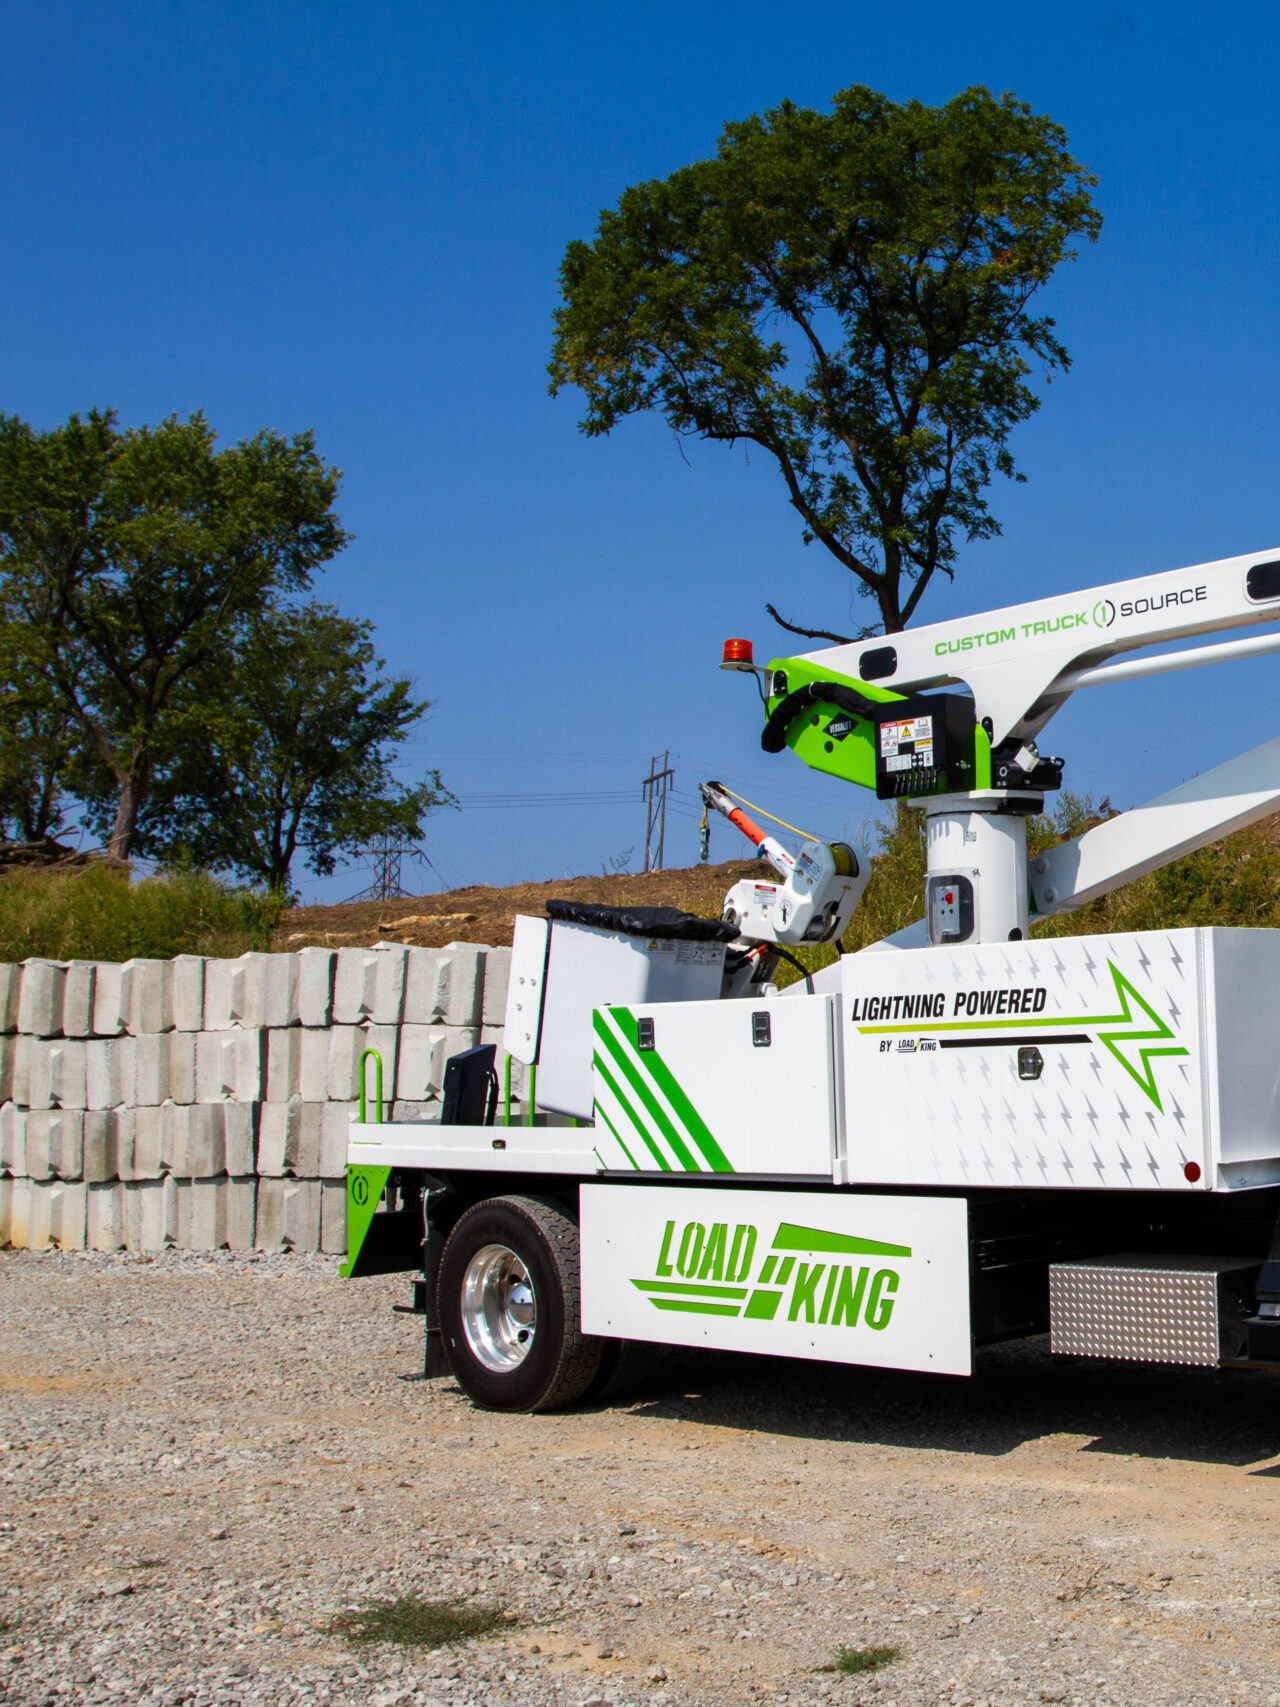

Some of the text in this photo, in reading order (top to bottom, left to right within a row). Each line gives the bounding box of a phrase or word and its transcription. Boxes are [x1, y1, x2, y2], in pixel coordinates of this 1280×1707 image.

[934, 628, 1016, 657] CUSTOM
[1021, 611, 1089, 638] TRUCK
[1120, 586, 1207, 617] SOURCE
[851, 987, 1047, 1022] LIGHTNING POWERED
[879, 1039, 937, 1052] BY LOAD KING
[655, 1220, 900, 1331] LOAD KING
